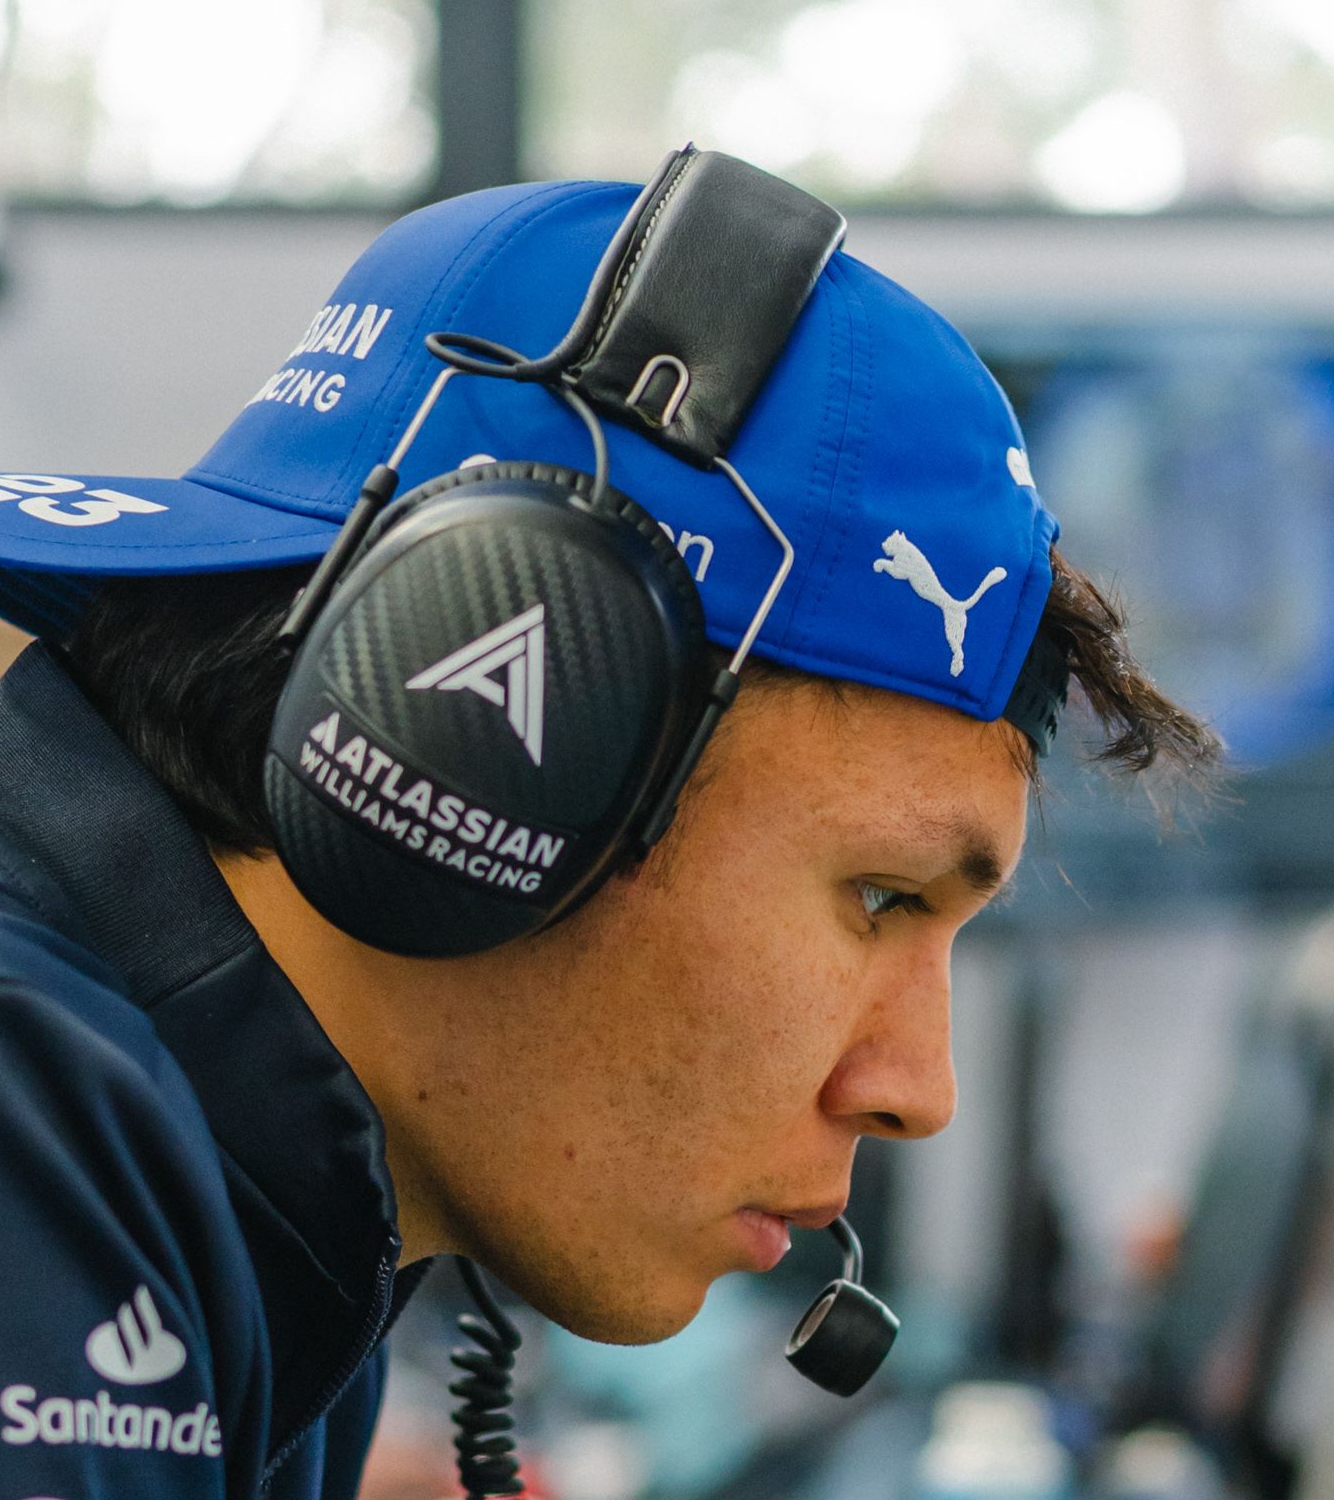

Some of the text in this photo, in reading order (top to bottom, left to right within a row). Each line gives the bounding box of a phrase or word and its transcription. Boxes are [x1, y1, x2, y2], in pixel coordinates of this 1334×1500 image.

[299, 740, 543, 894] WILLIAMS RACING
[335, 735, 565, 868] ATLASSIAN
